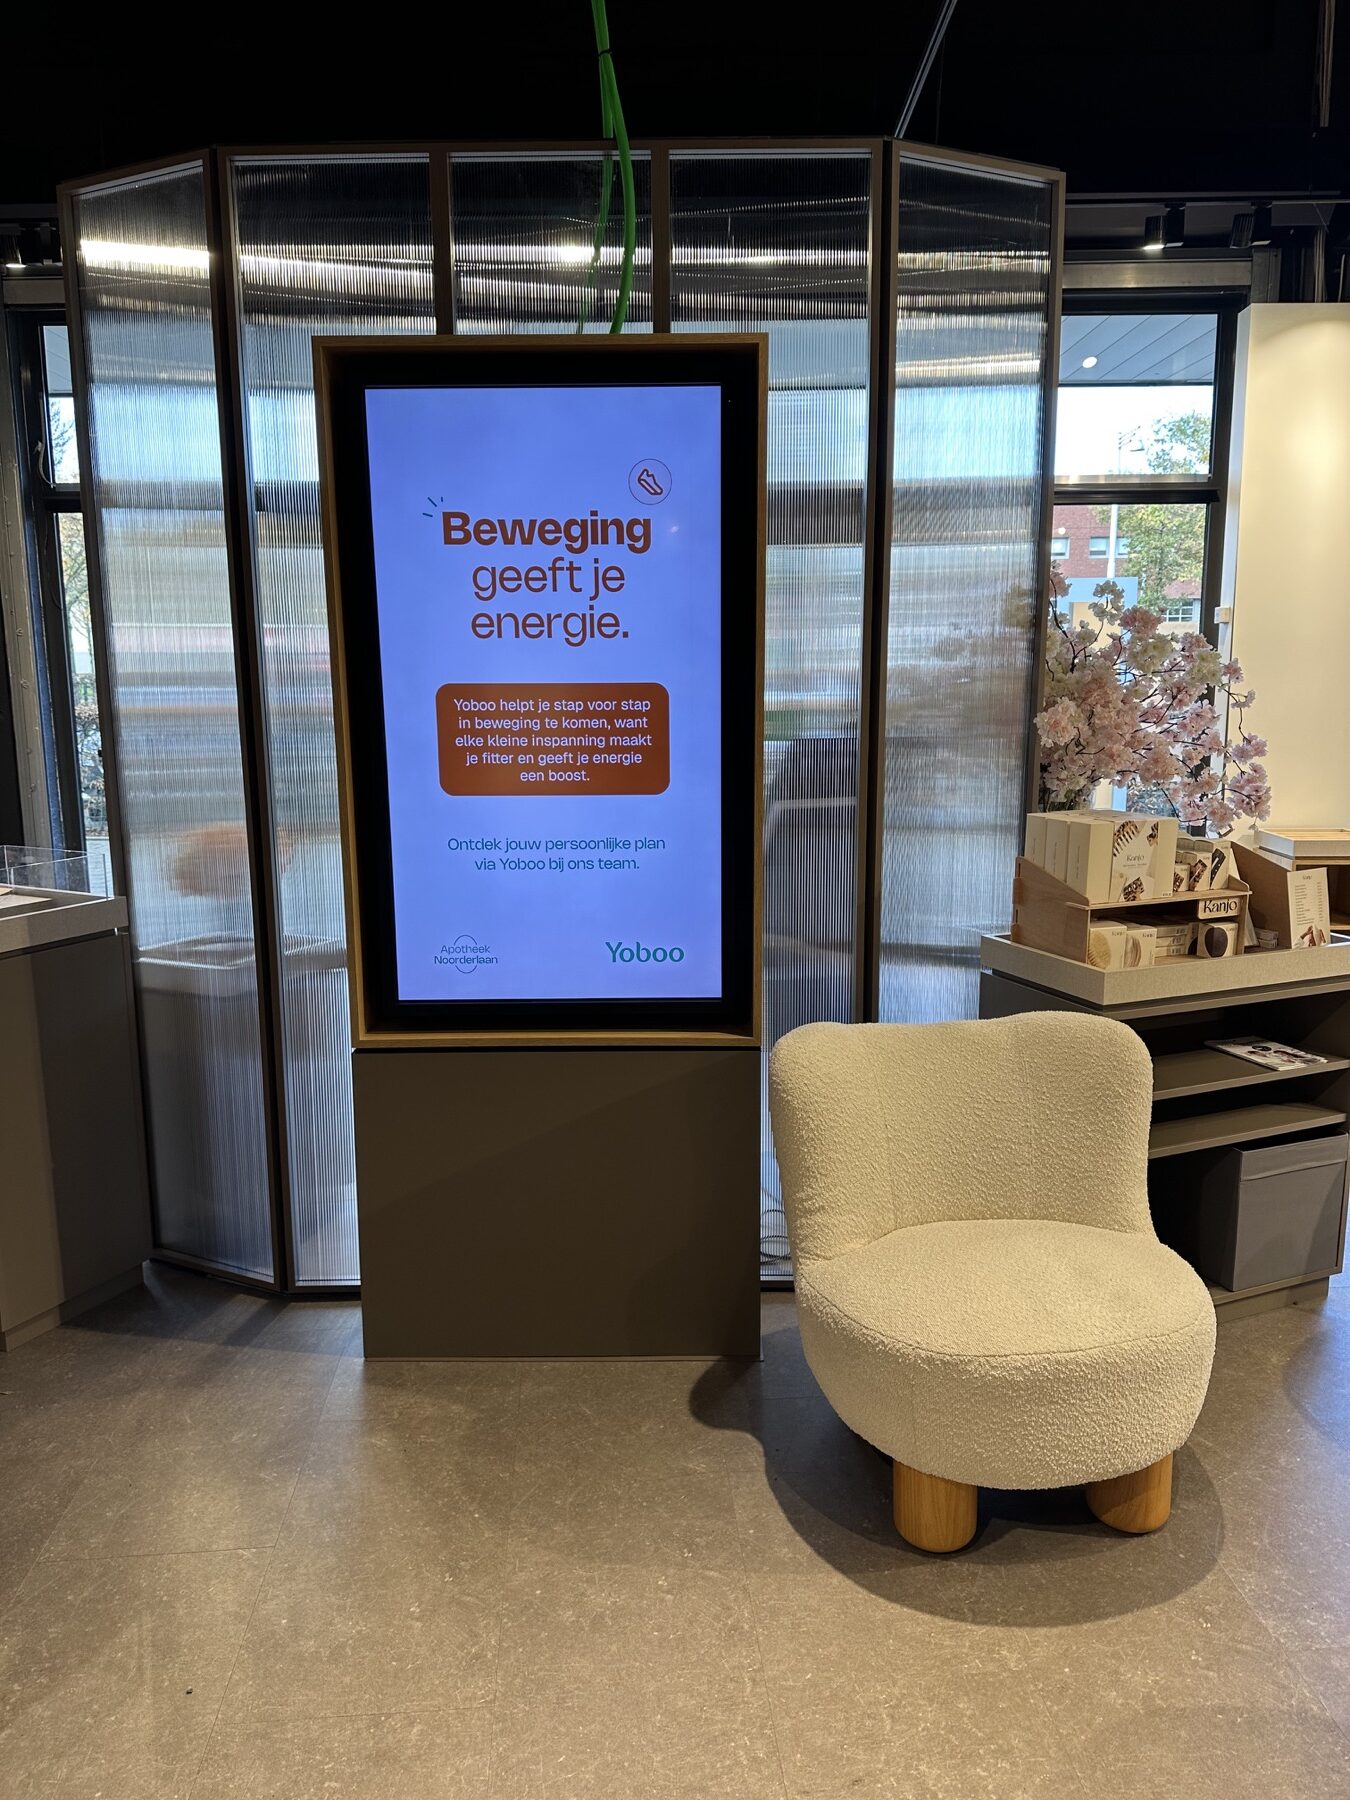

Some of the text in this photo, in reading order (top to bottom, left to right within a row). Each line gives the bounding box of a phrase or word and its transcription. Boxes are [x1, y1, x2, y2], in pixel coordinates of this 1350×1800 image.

[441, 510, 651, 554] Beweging
[471, 557, 625, 601] geeft je
[471, 604, 629, 647] energie.
[454, 698, 651, 713] Yoboo helpt je stap voor stap
[458, 716, 648, 731] in beweging te komen, want
[455, 734, 652, 748] elke kleine inspanning maakt
[466, 752, 642, 766] je fitter en geeft je energie
[520, 770, 590, 782] een boost.
[447, 837, 665, 853] Ontdek jouw persoonlijke plan
[474, 858, 640, 873] via Yoboo bij ons team.
[1204, 898, 1238, 914] Kanjo
[441, 945, 490, 956] Apotheek
[605, 941, 685, 963] Yoboo
[434, 955, 498, 965] Noorderlaan
